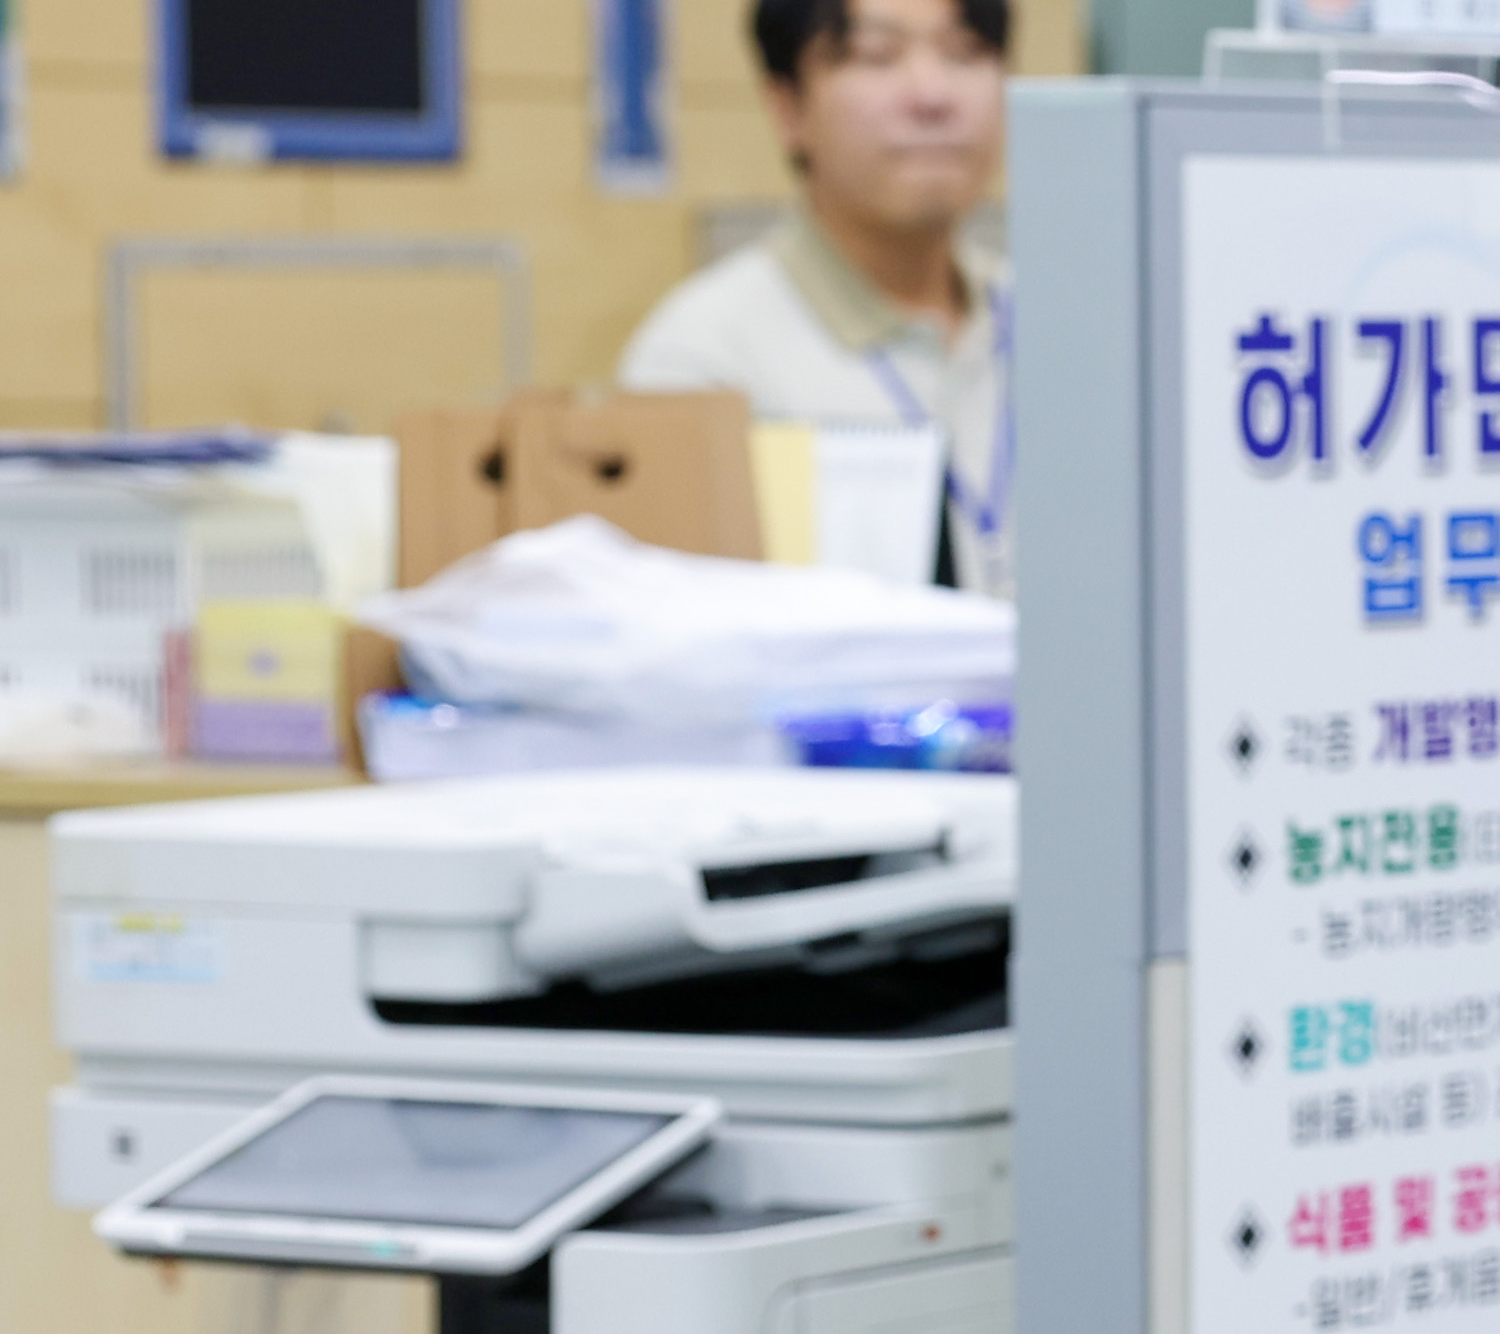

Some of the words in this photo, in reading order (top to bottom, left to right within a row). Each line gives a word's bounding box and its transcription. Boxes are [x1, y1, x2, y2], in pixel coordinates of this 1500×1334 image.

[1286, 713, 1354, 773] 각종
[1289, 1180, 1375, 1255] 식품
[1395, 1175, 1434, 1243] 및
